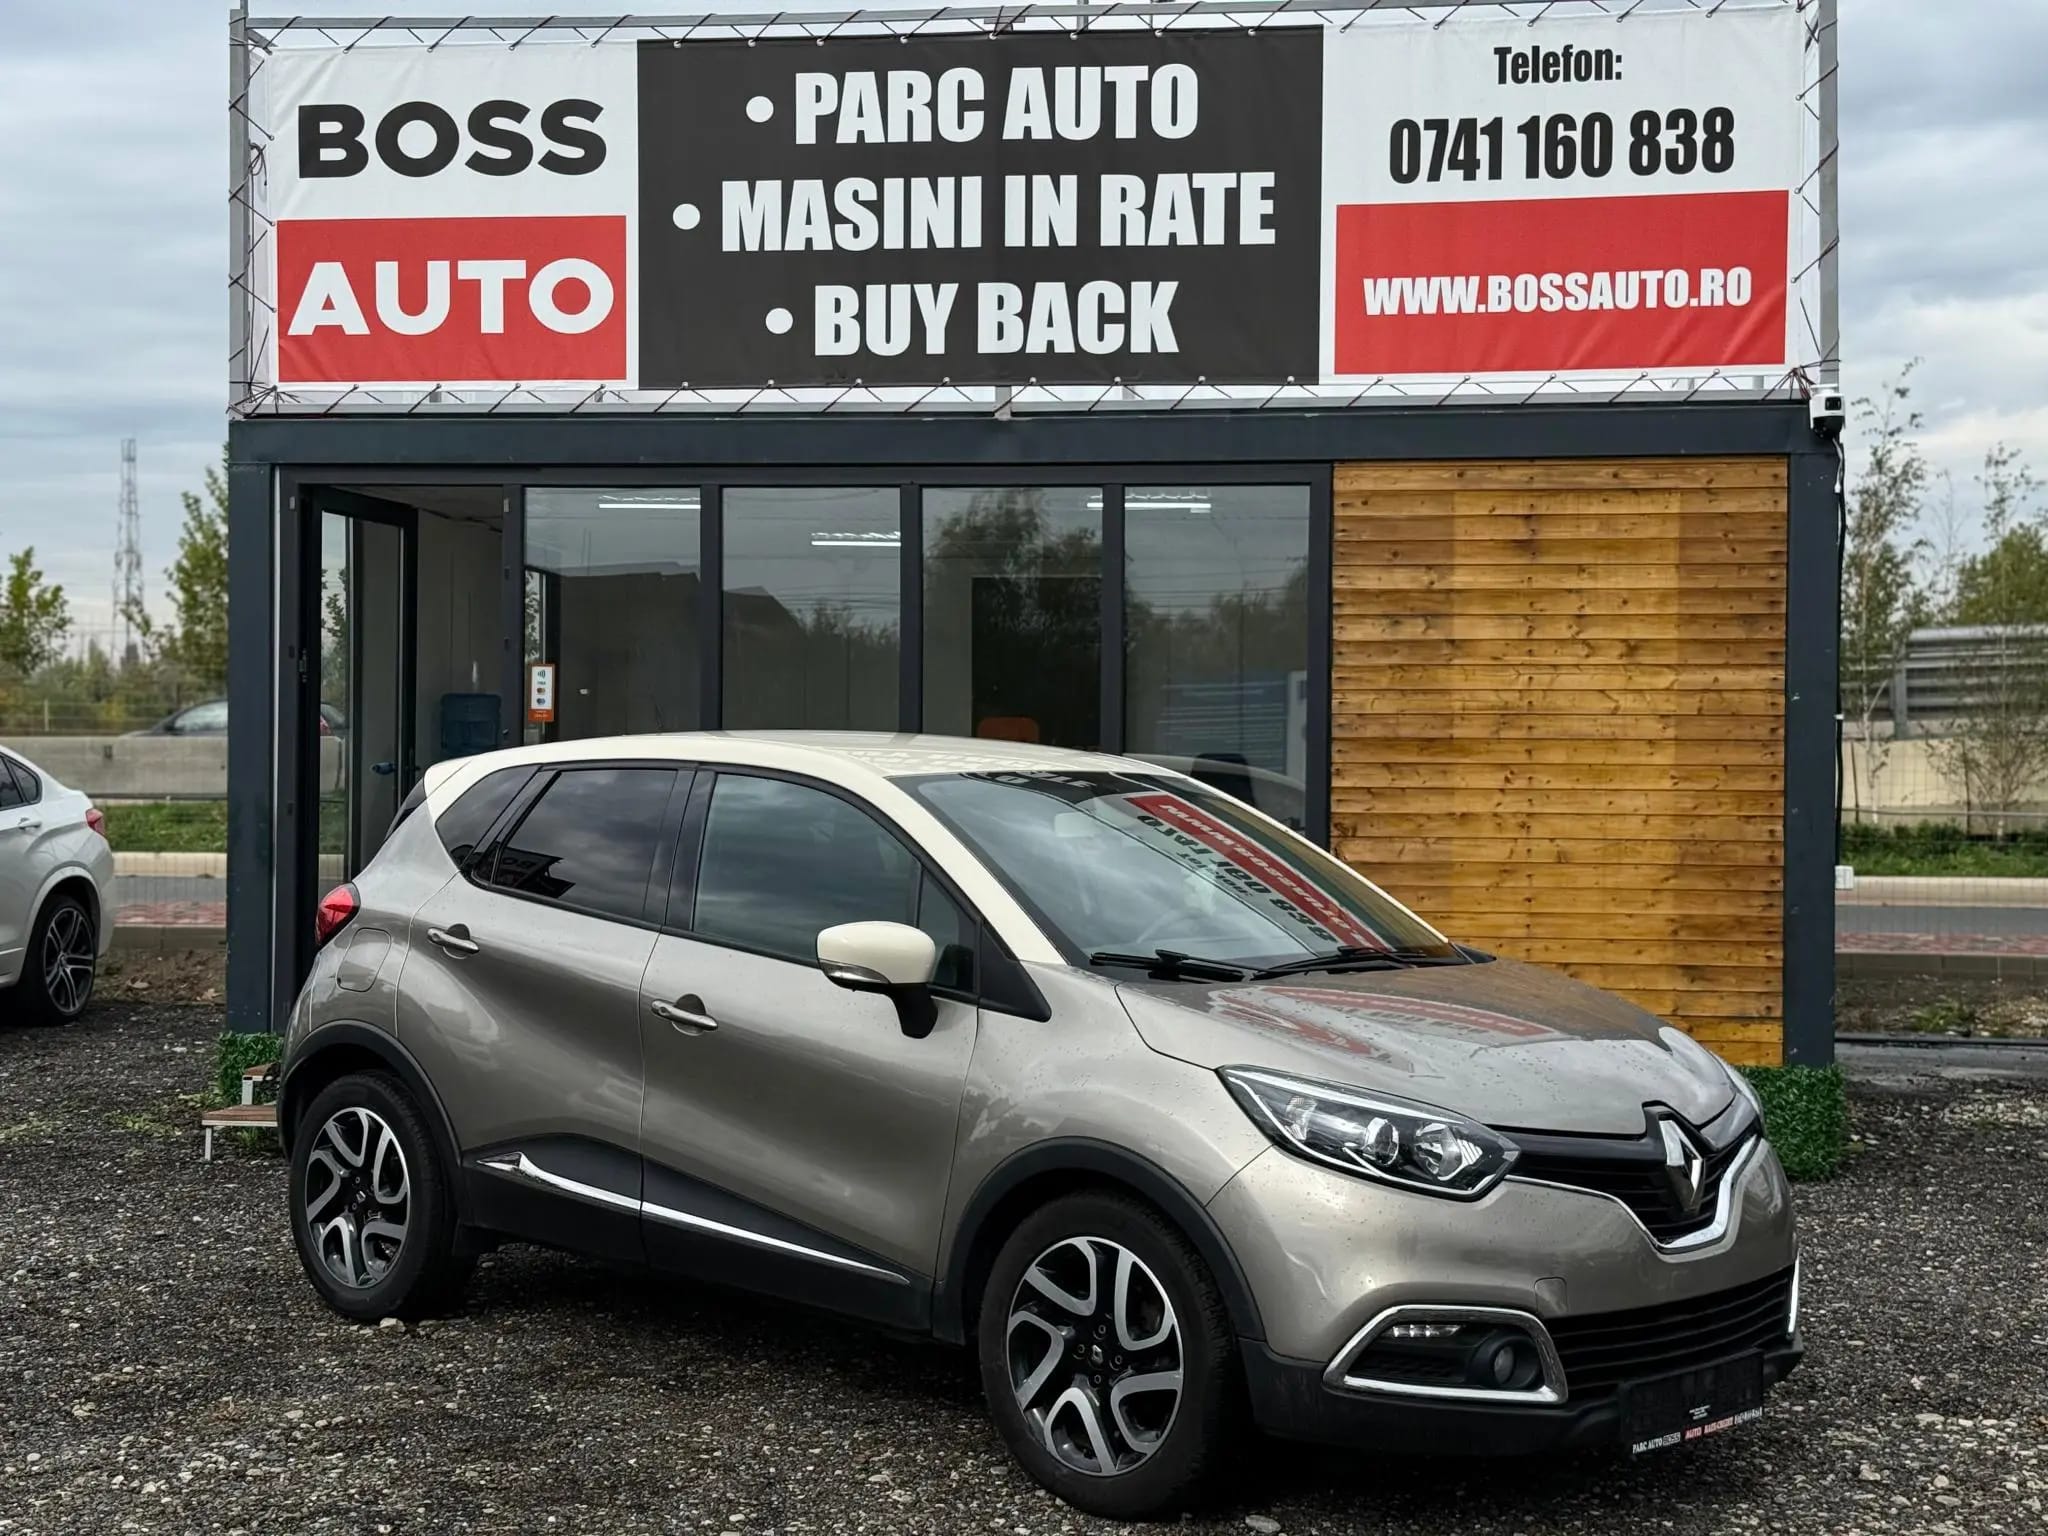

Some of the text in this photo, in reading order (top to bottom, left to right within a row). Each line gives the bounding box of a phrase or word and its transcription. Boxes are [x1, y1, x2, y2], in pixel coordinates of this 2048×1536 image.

[1494, 44, 1622, 85] Telefon:
[298, 99, 607, 178] BOSS
[796, 64, 1199, 145] PARC AUTO
[1389, 107, 1735, 184] 0741 160 838
[722, 172, 1276, 252] MASINI IN RATE
[288, 258, 615, 336] AUTO
[815, 280, 1180, 357] BUY BACK
[1363, 267, 1752, 316] WWW.BOSSAUTO.RO
[1632, 1440, 1648, 1454] PARC
[1647, 1436, 1663, 1450] AUTO
